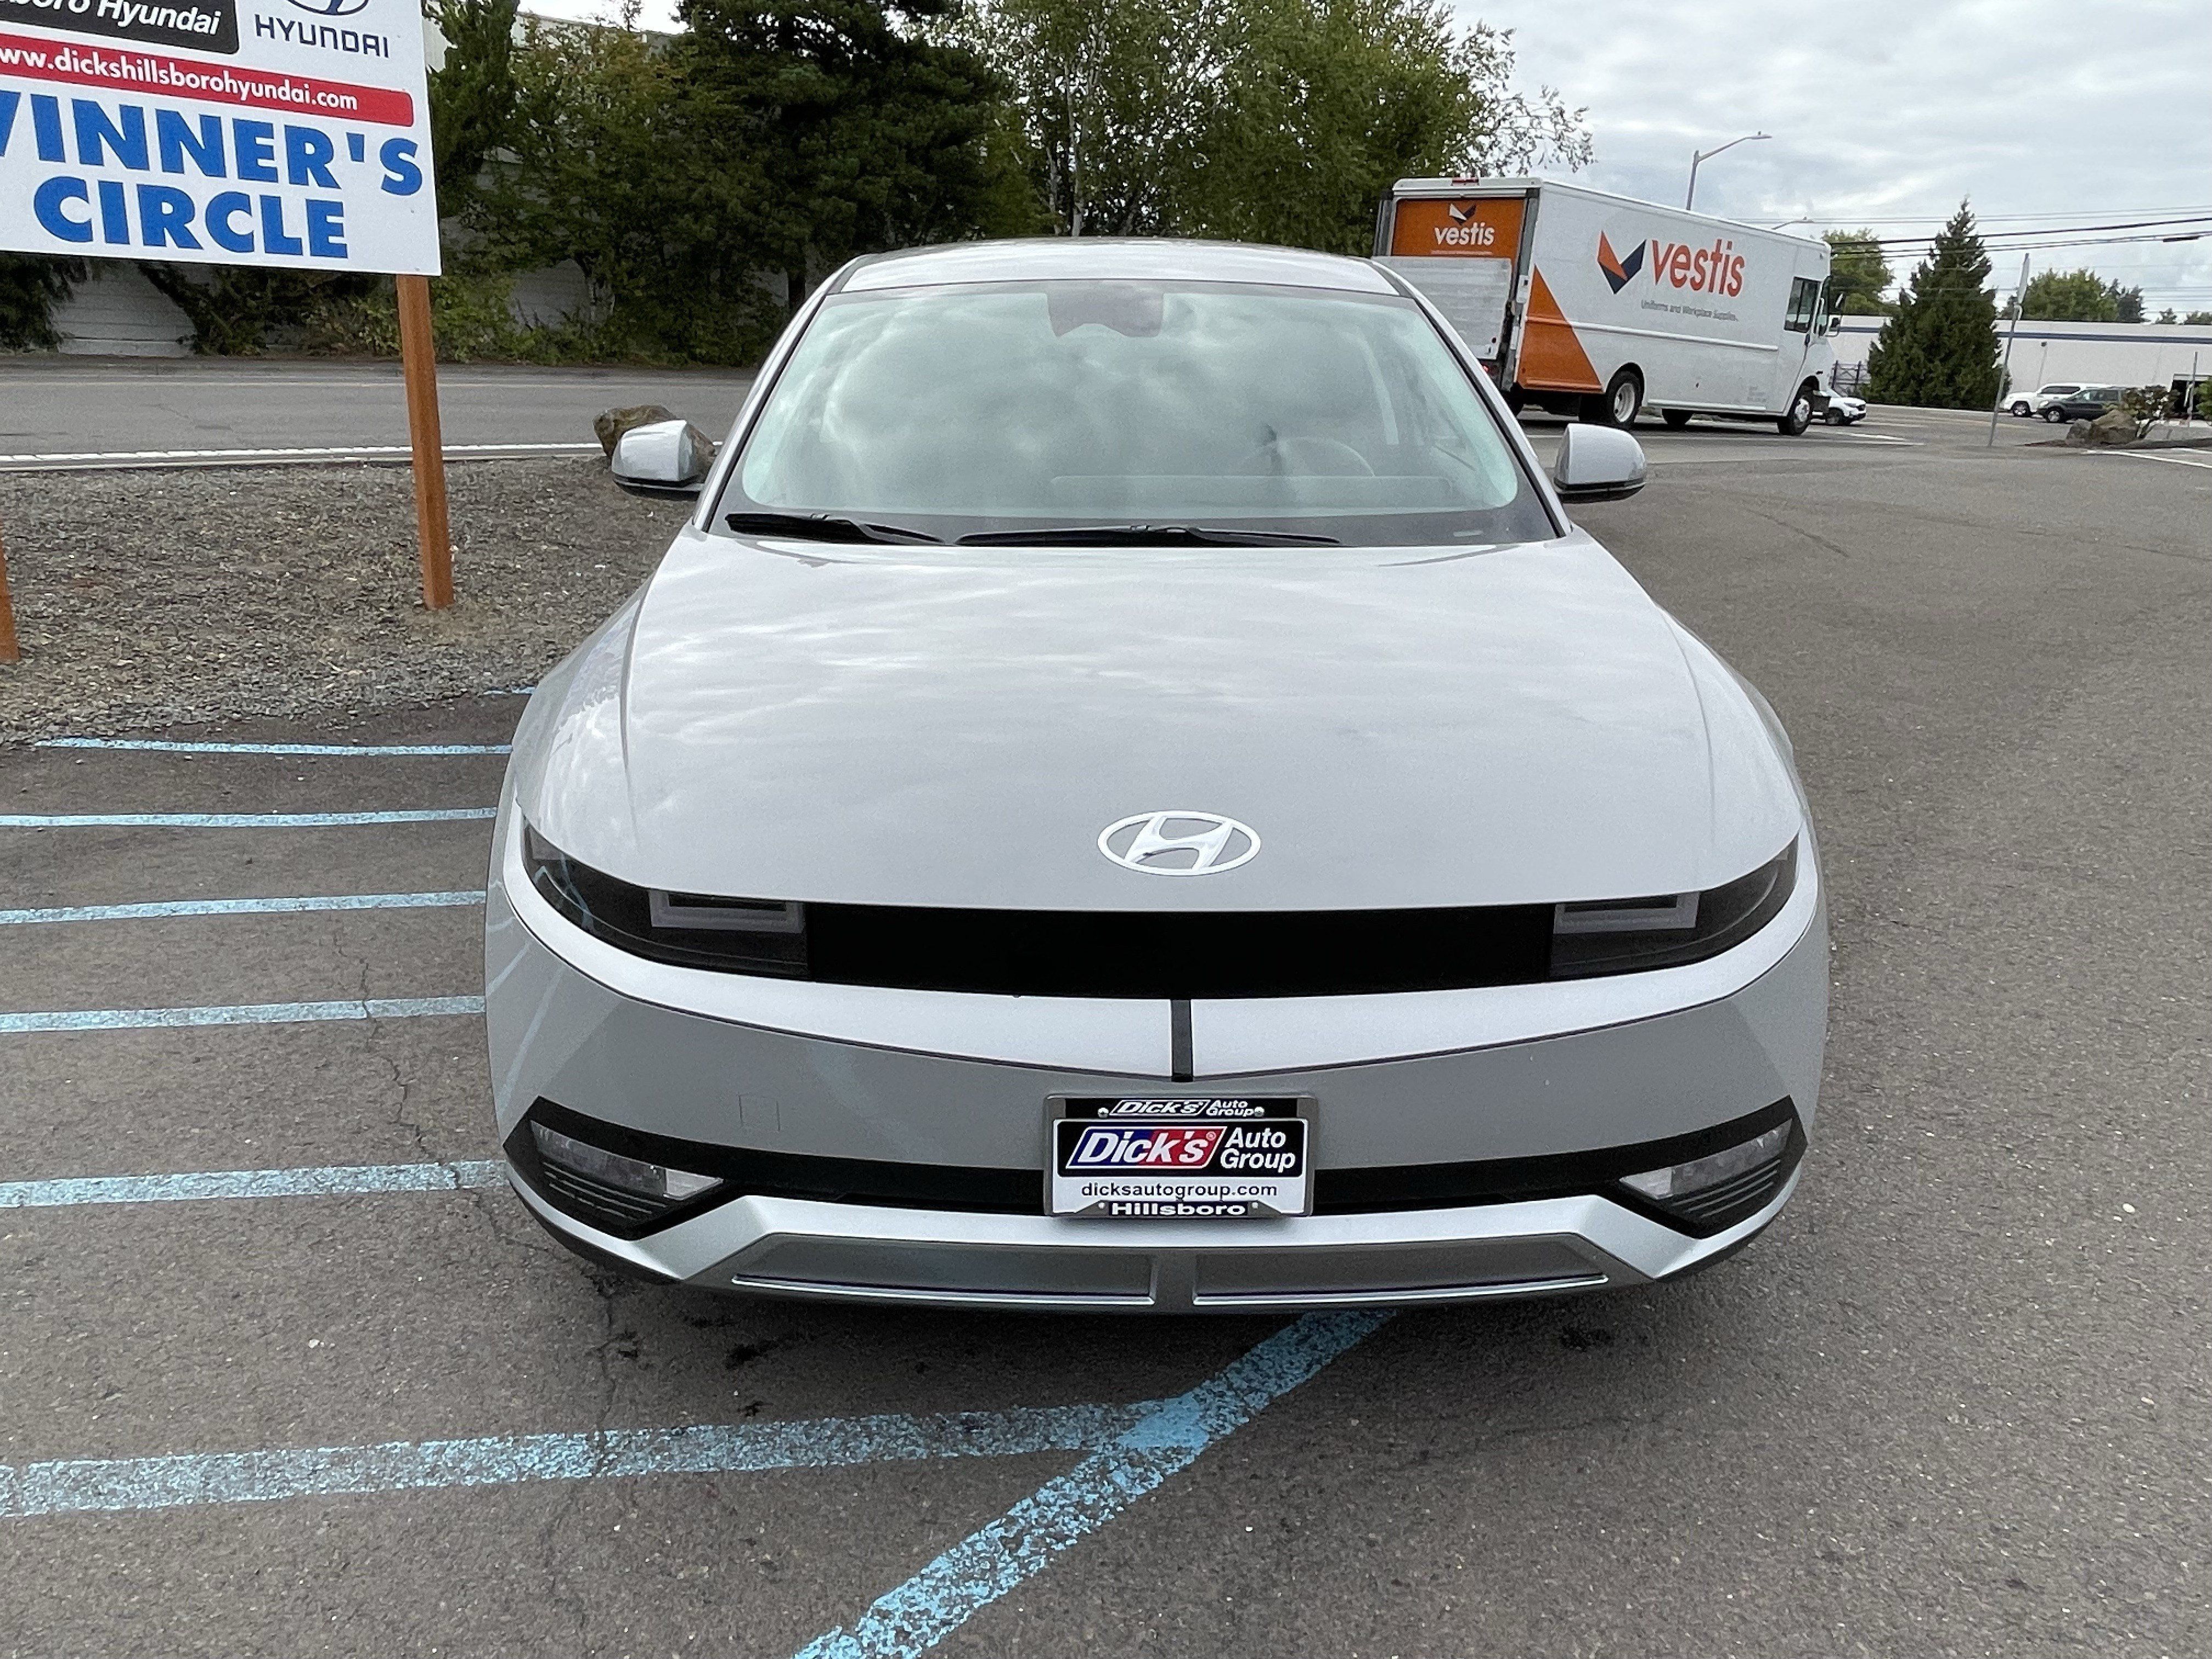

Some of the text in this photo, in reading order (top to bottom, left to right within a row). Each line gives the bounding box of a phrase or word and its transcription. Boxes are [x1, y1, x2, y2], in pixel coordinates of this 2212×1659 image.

[97, 0, 221, 35] Hyundai
[254, 14, 390, 58] HYUNDAI
[33, 176, 348, 259] CIRCLE
[1434, 222, 1495, 246] vestis
[1651, 238, 1745, 297] vestis
[1206, 1107, 1254, 1117] Group
[1210, 1099, 1249, 1108] Auto
[1224, 1127, 1286, 1149] Auto
[1220, 1148, 1296, 1173] Group
[1081, 1182, 1277, 1201] dicksautogroup.com
[1111, 1202, 1246, 1216] Hillsboro
